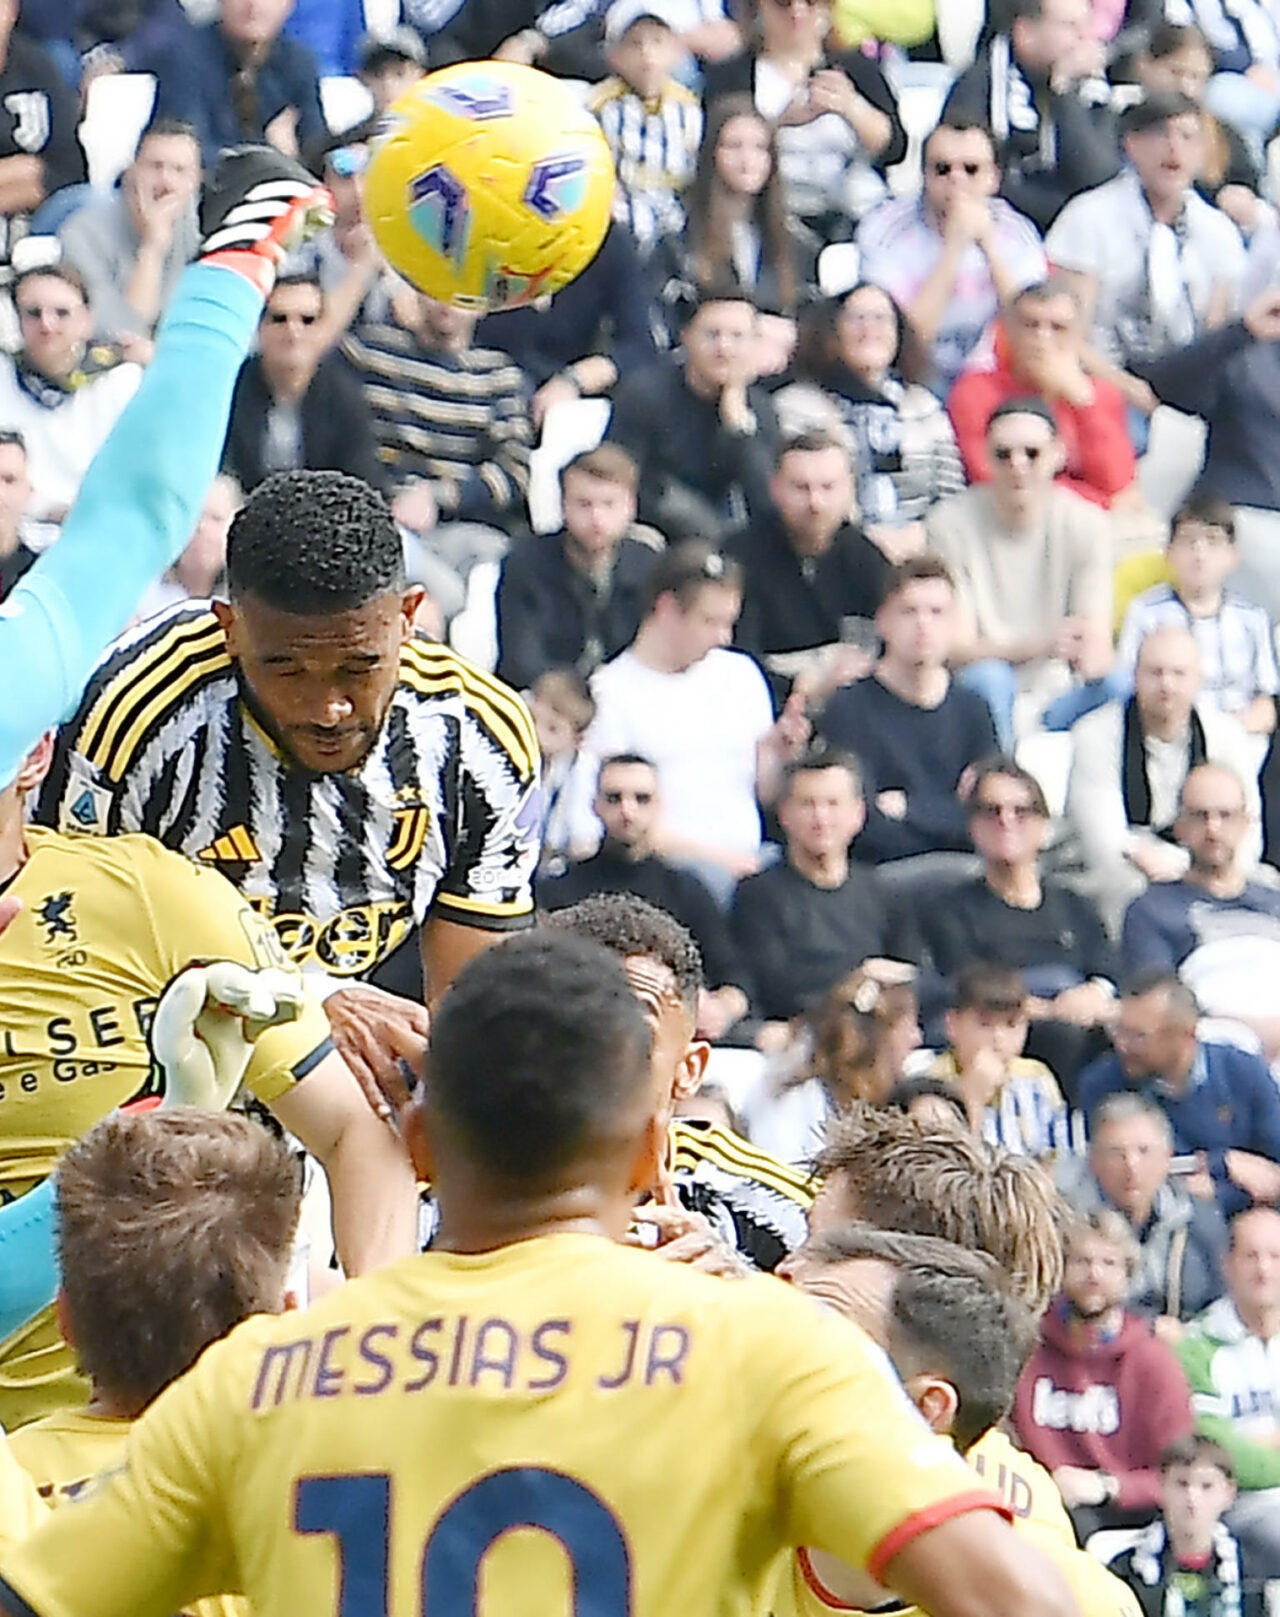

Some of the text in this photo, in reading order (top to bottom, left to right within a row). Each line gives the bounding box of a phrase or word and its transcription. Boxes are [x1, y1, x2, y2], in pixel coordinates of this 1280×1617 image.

[20, 1072, 38, 1093] e
[252, 1315, 690, 1411] MESSIAS JR
